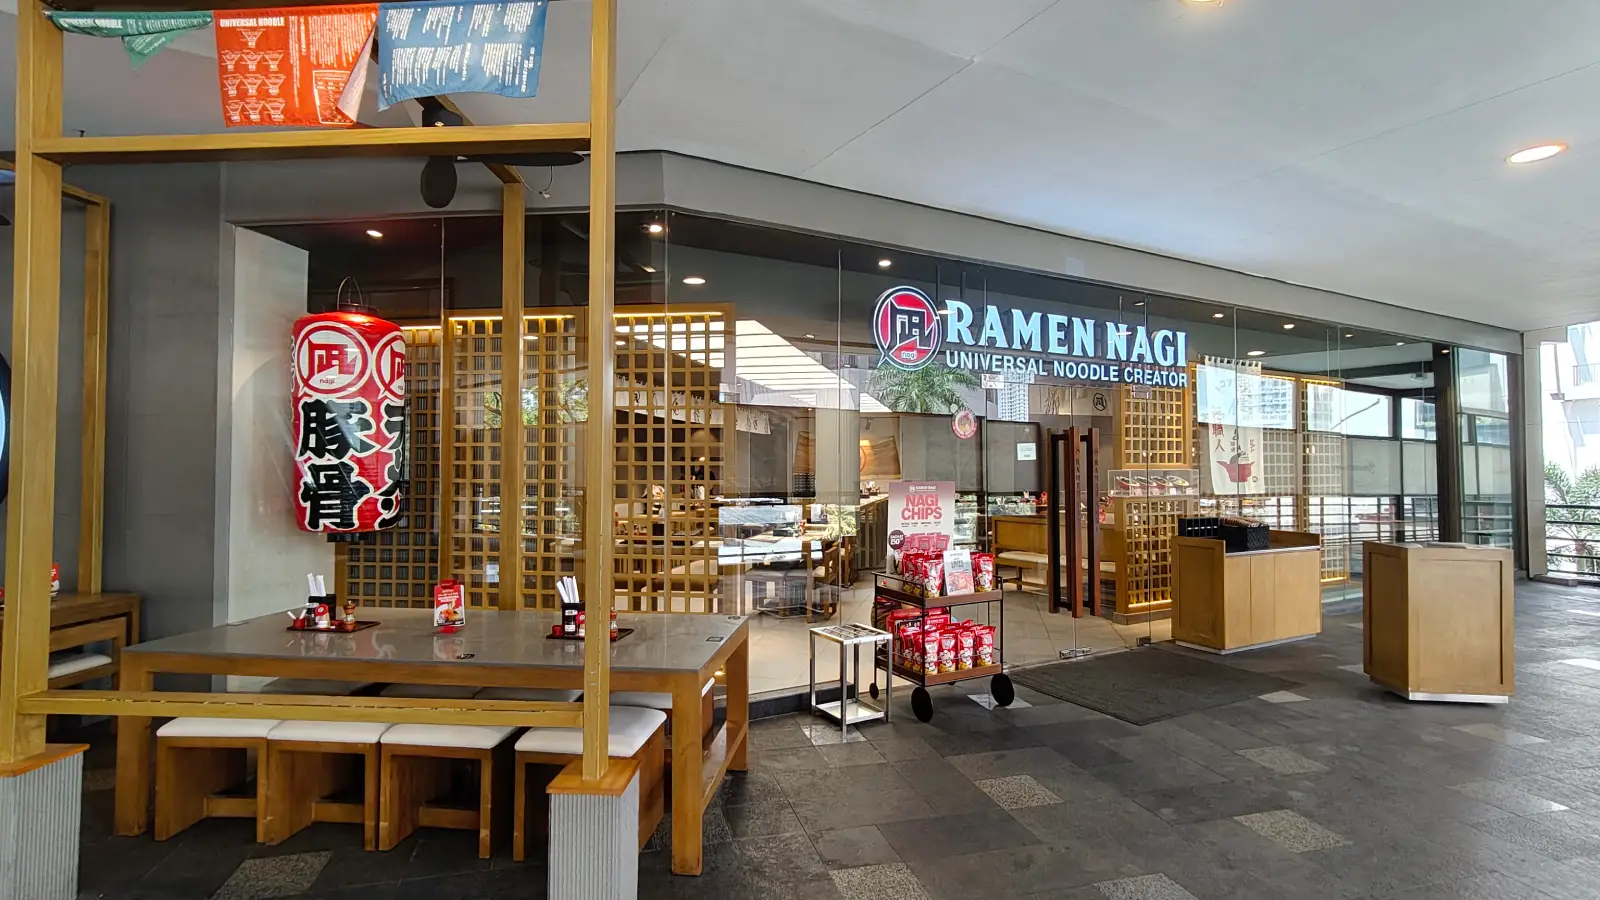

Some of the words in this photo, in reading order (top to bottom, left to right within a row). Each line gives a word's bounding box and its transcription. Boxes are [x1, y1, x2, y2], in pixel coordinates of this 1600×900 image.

[219, 18, 257, 28] UNIVERSAL
[258, 16, 285, 27] NOODLE
[945, 299, 1096, 357] RAMEN
[1106, 321, 1187, 367] NAGI
[901, 350, 918, 360] nagi
[945, 349, 1048, 376] UNIVERSAL
[1057, 362, 1119, 383] NOODLE
[1124, 367, 1188, 388] CREATOR
[904, 493, 939, 507] NAGI
[900, 506, 943, 521] CHIPS
